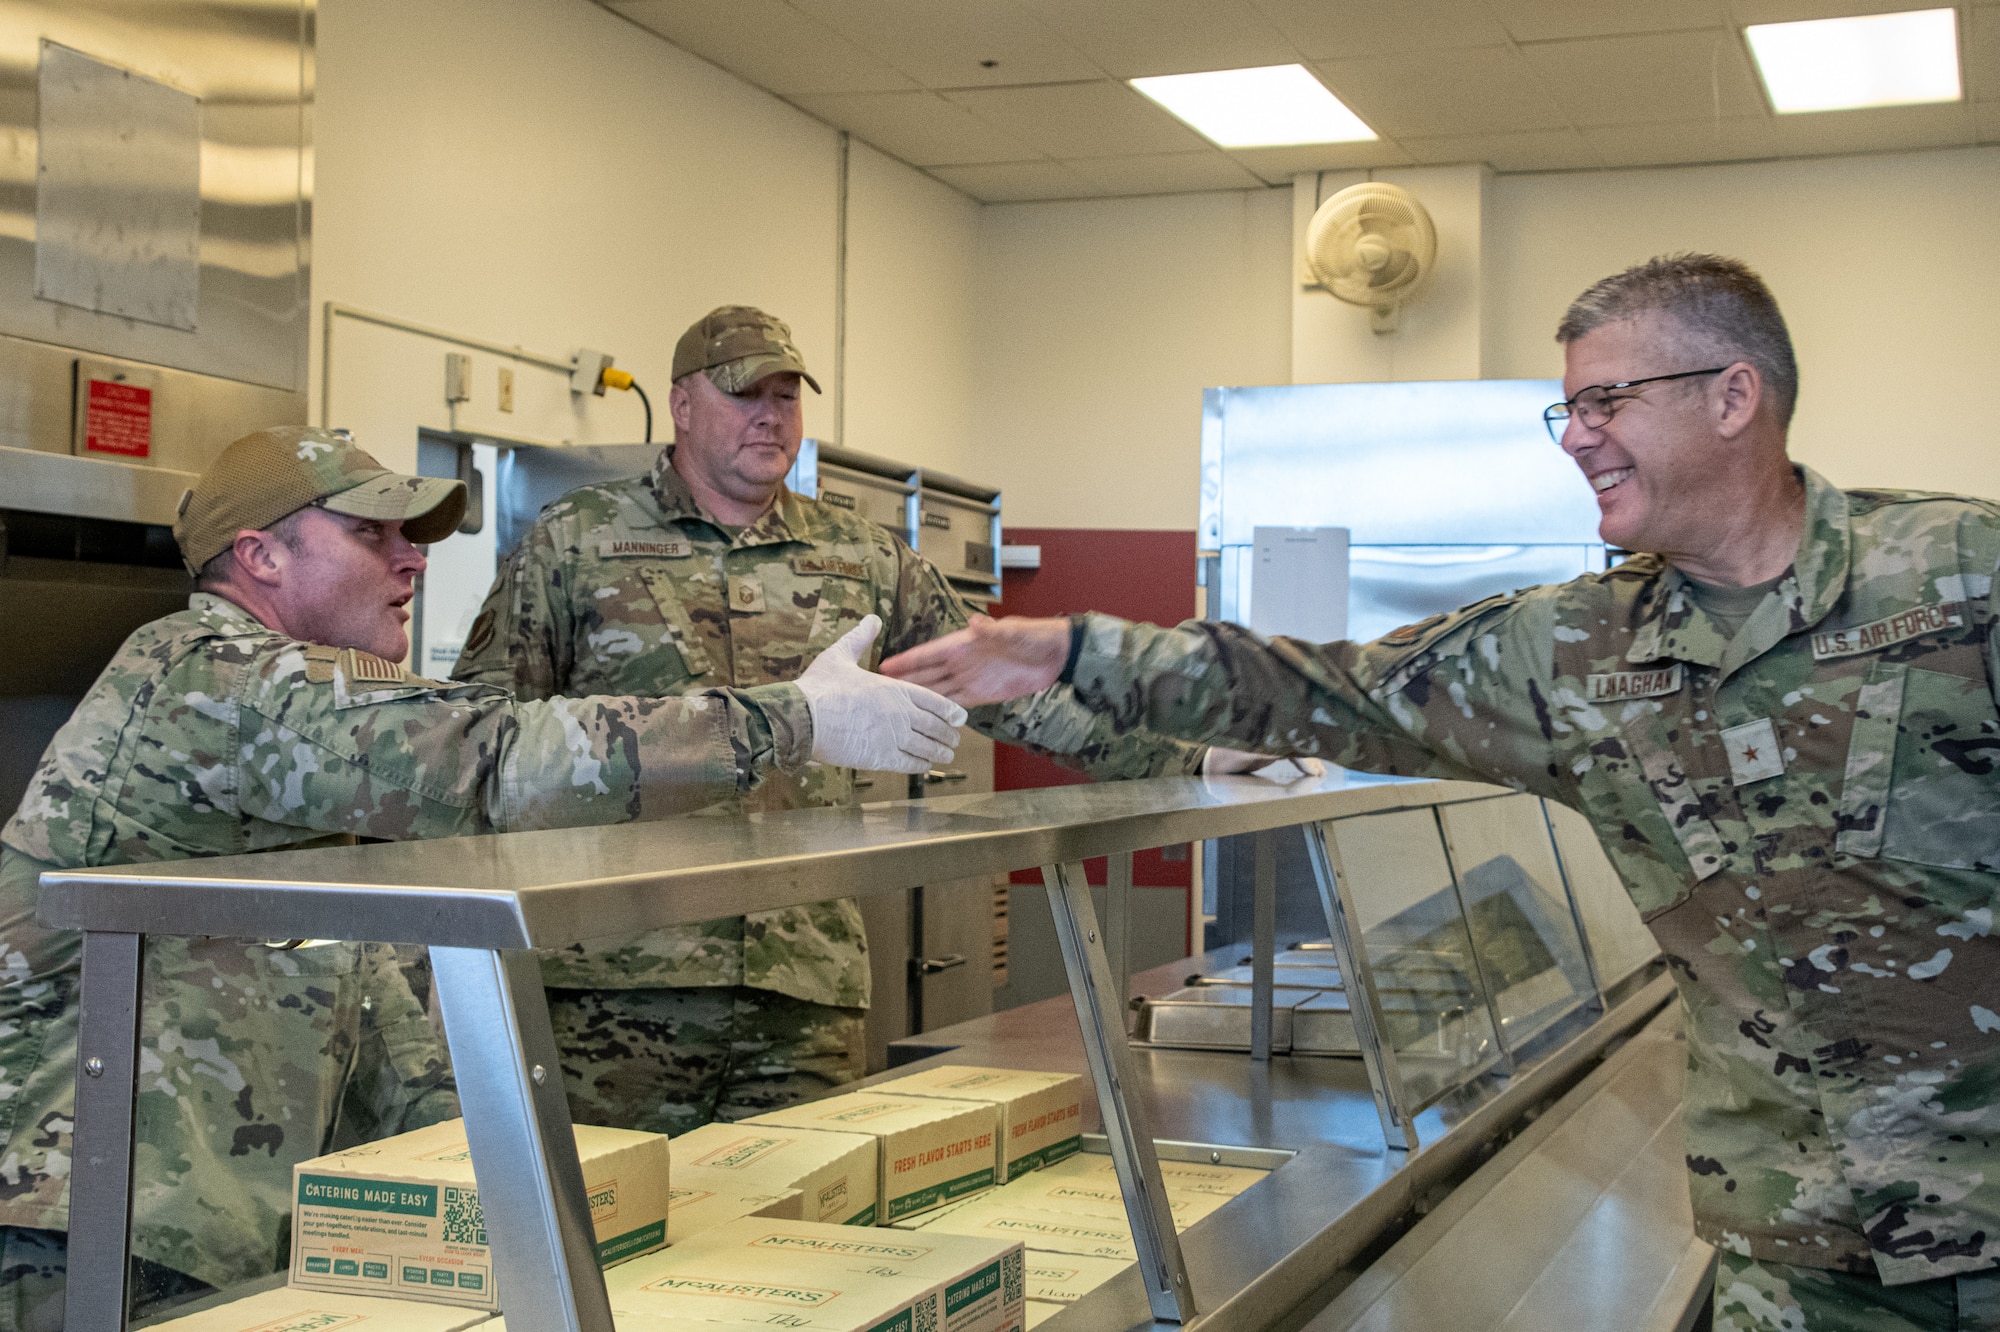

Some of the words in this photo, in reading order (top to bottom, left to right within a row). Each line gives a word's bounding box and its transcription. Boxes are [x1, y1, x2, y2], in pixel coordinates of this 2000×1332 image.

[612, 541, 679, 554] MANNINGER
[1815, 632, 1853, 655] U.S.
[1859, 622, 1890, 649] AIR
[1892, 603, 1957, 639] FORCE
[894, 1156, 916, 1174] FRESH
[918, 1147, 945, 1167] FLAVOR
[946, 1138, 973, 1158] STARTS
[974, 1132, 992, 1150] HERE
[305, 1183, 360, 1201] CATERING
[364, 1189, 396, 1204] MADE
[401, 1193, 428, 1207] EASY
[947, 1289, 971, 1308] CATERING
[971, 1277, 985, 1295] MADE
[986, 1271, 998, 1288] EASY
